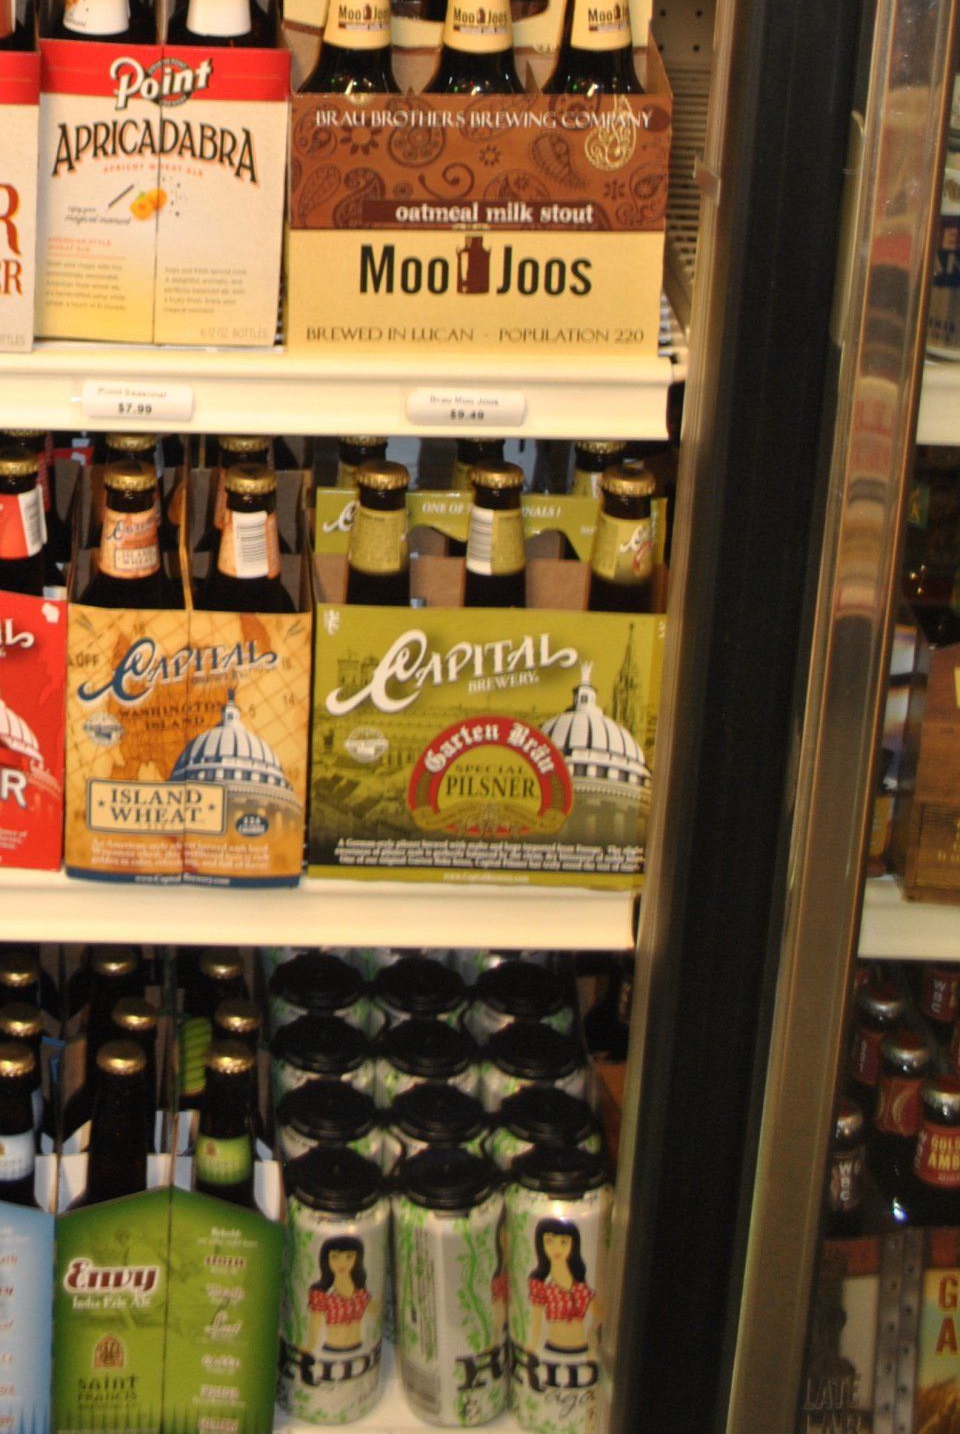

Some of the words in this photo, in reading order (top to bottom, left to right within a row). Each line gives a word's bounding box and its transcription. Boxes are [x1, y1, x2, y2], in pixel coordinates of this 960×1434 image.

[338, 4, 362, 21] Moo
[452, 7, 476, 23] Moo
[109, 57, 213, 111] Point
[316, 109, 368, 128] BRAU
[371, 110, 465, 129] BROTHERS
[470, 111, 557, 129] BREWING
[561, 111, 654, 130] COMPANY
[50, 118, 259, 185] APRICADABRA
[394, 200, 478, 223] oatmeal
[484, 200, 534, 223] milk
[540, 201, 595, 224] stout
[360, 244, 451, 295] Moo
[495, 244, 593, 296] Joos
[306, 326, 384, 342] BREWED
[388, 326, 407, 342] IN
[411, 327, 475, 342] LUCAN
[498, 327, 609, 343] POPULATION
[614, 327, 645, 343] 220
[118, 402, 153, 415] $7.99
[325, 629, 579, 715] CAPITAL
[468, 669, 538, 695] BREWERY
[111, 787, 203, 805] ISLAND
[446, 776, 536, 799] PILSNER
[111, 806, 201, 825] WHEAT
[63, 1257, 161, 1295] Envy
